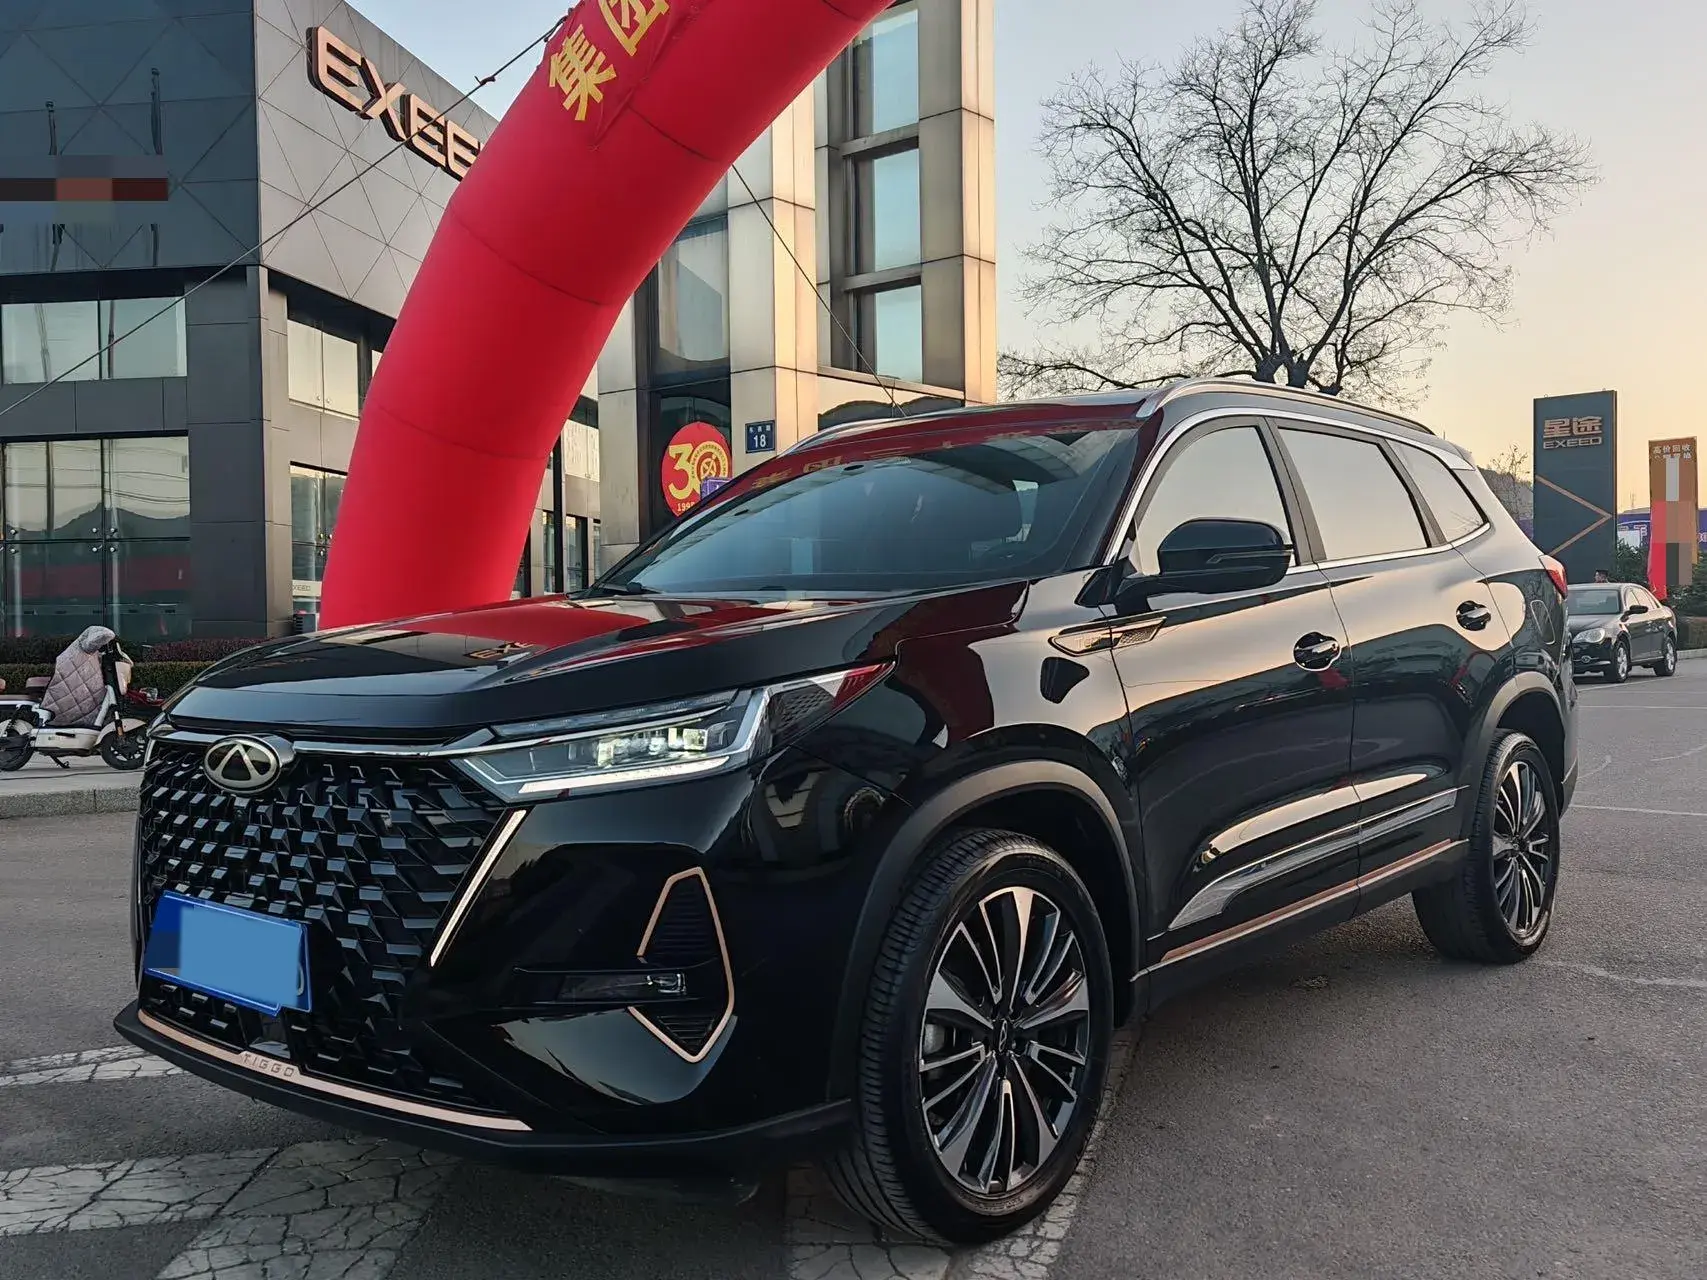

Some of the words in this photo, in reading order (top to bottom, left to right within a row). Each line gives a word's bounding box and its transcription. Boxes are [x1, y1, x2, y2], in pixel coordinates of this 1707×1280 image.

[307, 26, 485, 181] EXEE
[1543, 416, 1602, 438] 星途
[753, 434, 766, 448] 18
[1543, 437, 1602, 449] EXEED
[243, 1053, 295, 1077] TIGGO
